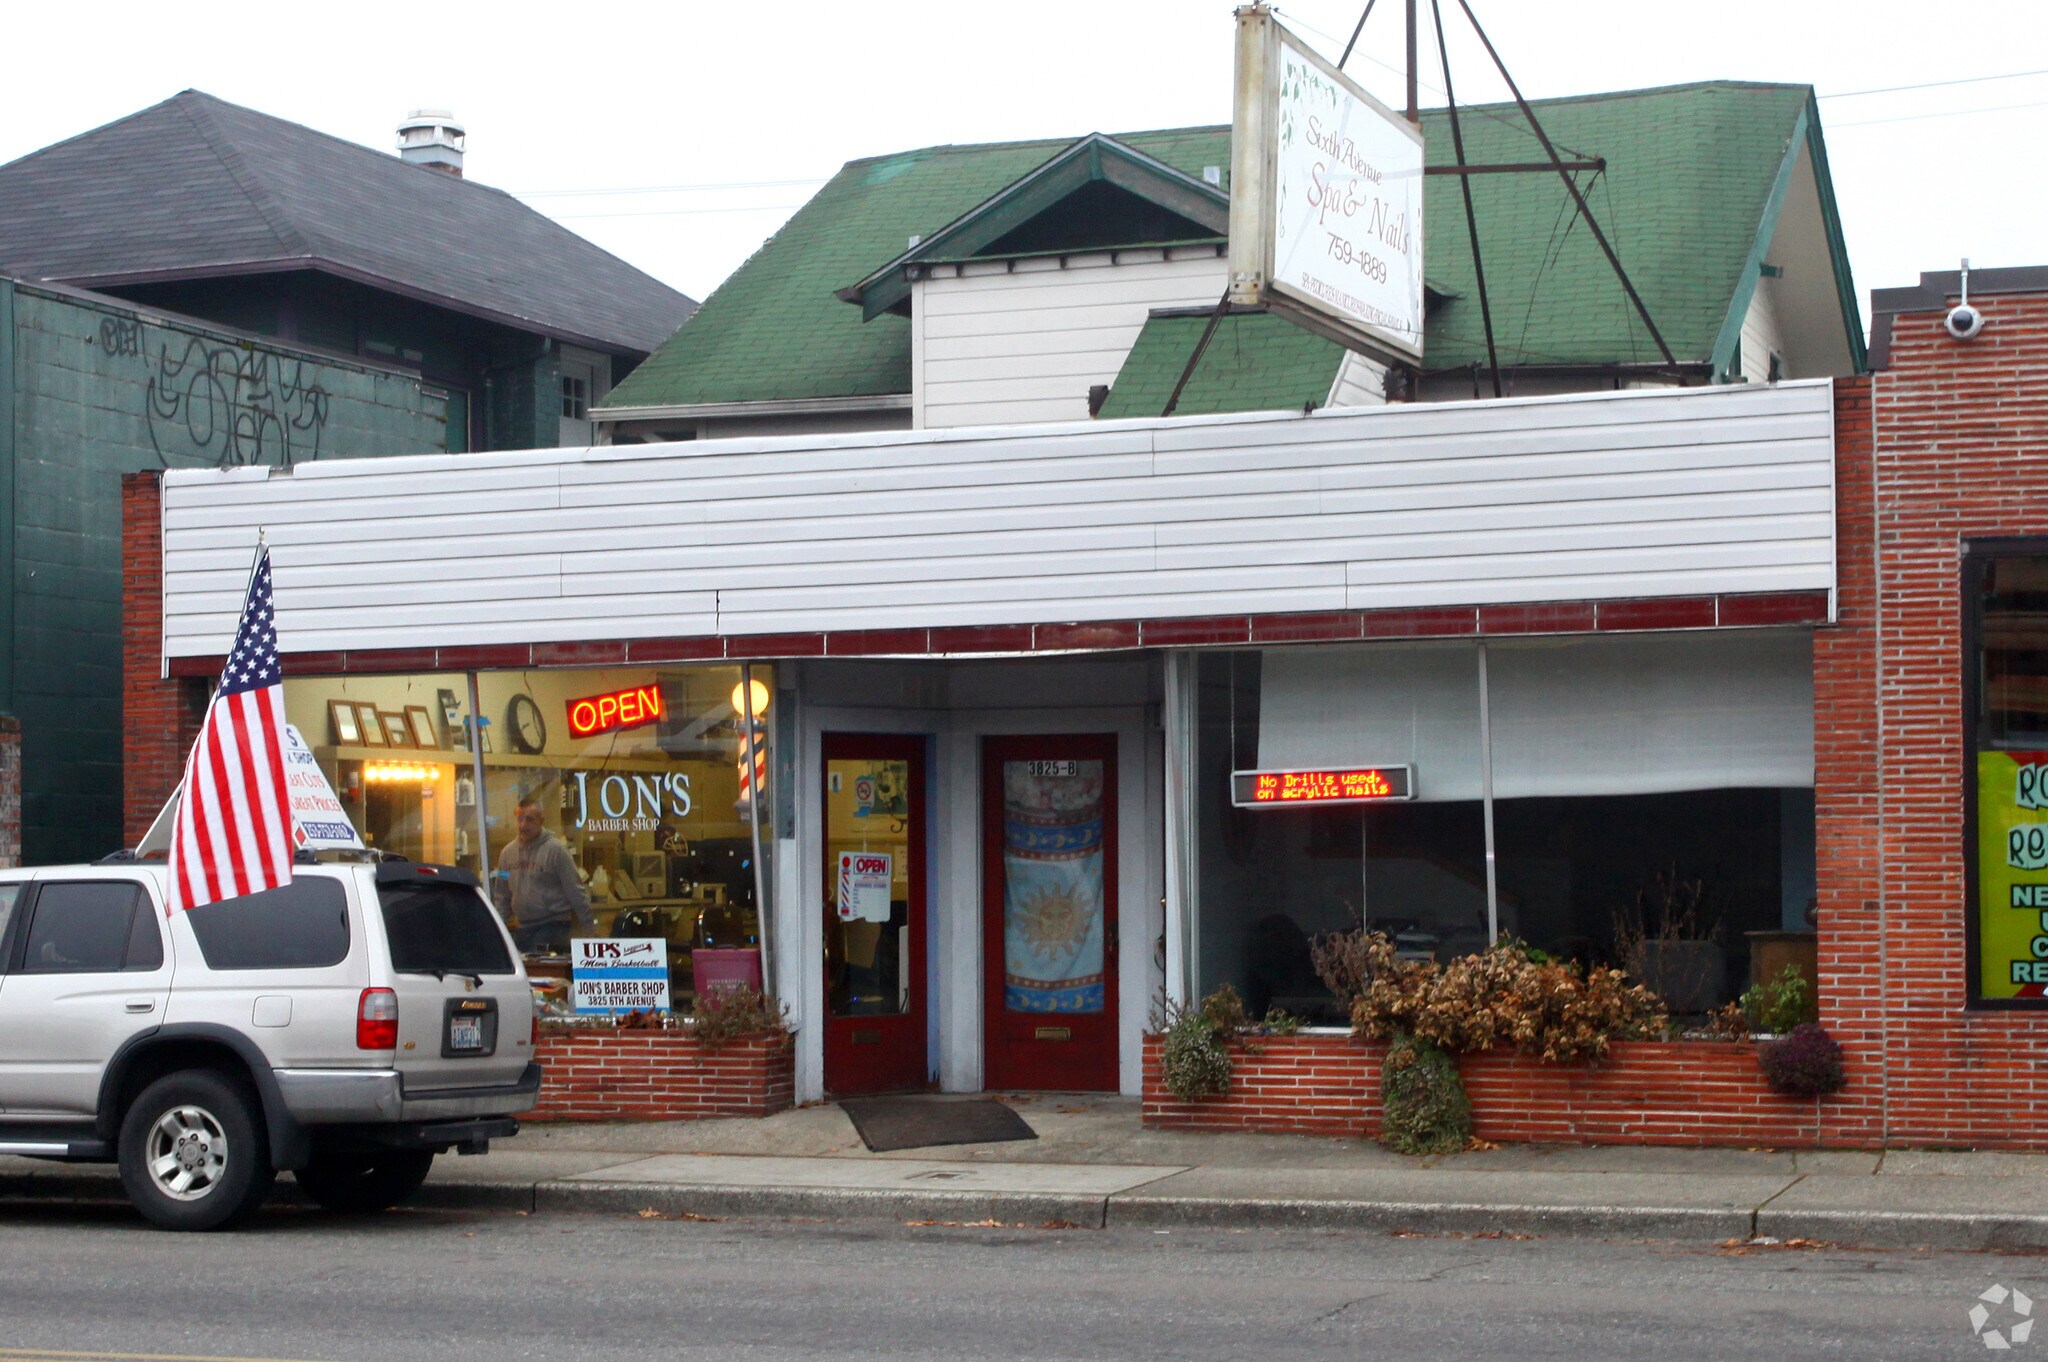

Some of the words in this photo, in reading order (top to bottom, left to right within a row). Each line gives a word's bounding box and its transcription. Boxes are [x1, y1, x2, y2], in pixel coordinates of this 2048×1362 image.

[1306, 115, 1340, 161] Sixth
[1341, 138, 1382, 185] Avenue
[1307, 162, 1341, 224] Spa
[1343, 179, 1366, 217] &
[1367, 197, 1409, 255] Nails
[1327, 232, 1387, 285] 759-1889
[573, 686, 660, 732] OPEN
[1028, 761, 1076, 776] 3825-B
[1259, 776, 1277, 789] No
[1284, 774, 1334, 787] Drills
[1257, 789, 1274, 799] on
[1282, 785, 1339, 799] acrylic
[1346, 783, 1389, 796] nails
[574, 771, 692, 829] JON'S
[588, 819, 630, 832] BARBER
[632, 818, 660, 831] SHOP
[856, 858, 886, 873] OPEN
[583, 942, 621, 959] UPS
[611, 959, 660, 968] Basketball
[578, 982, 602, 995] JON'S
[605, 982, 639, 995] BARBER
[641, 982, 665, 995] SHOP
[588, 996, 607, 1006] 3825
[609, 996, 624, 1006] 6TH
[626, 996, 656, 1006] AVENUE
